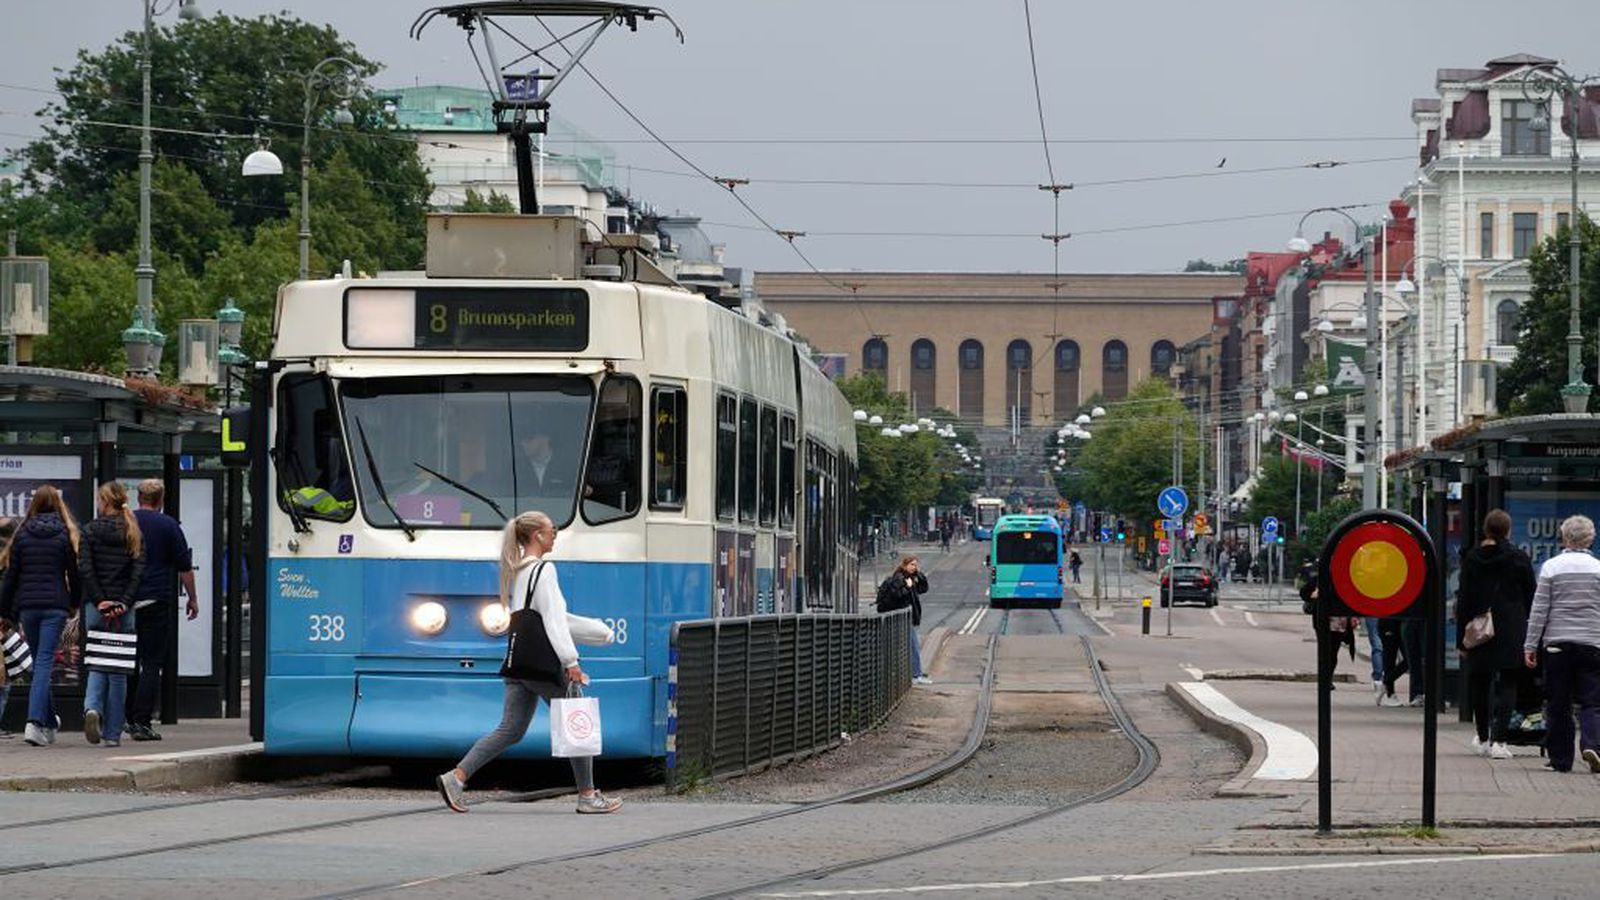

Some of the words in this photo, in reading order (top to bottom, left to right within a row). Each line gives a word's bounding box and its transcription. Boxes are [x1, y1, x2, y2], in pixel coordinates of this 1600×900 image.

[430, 304, 447, 333] 8
[458, 308, 576, 330] Brunnsparken
[423, 501, 433, 519] 8
[308, 614, 345, 641] 338
[604, 618, 627, 644] 38
